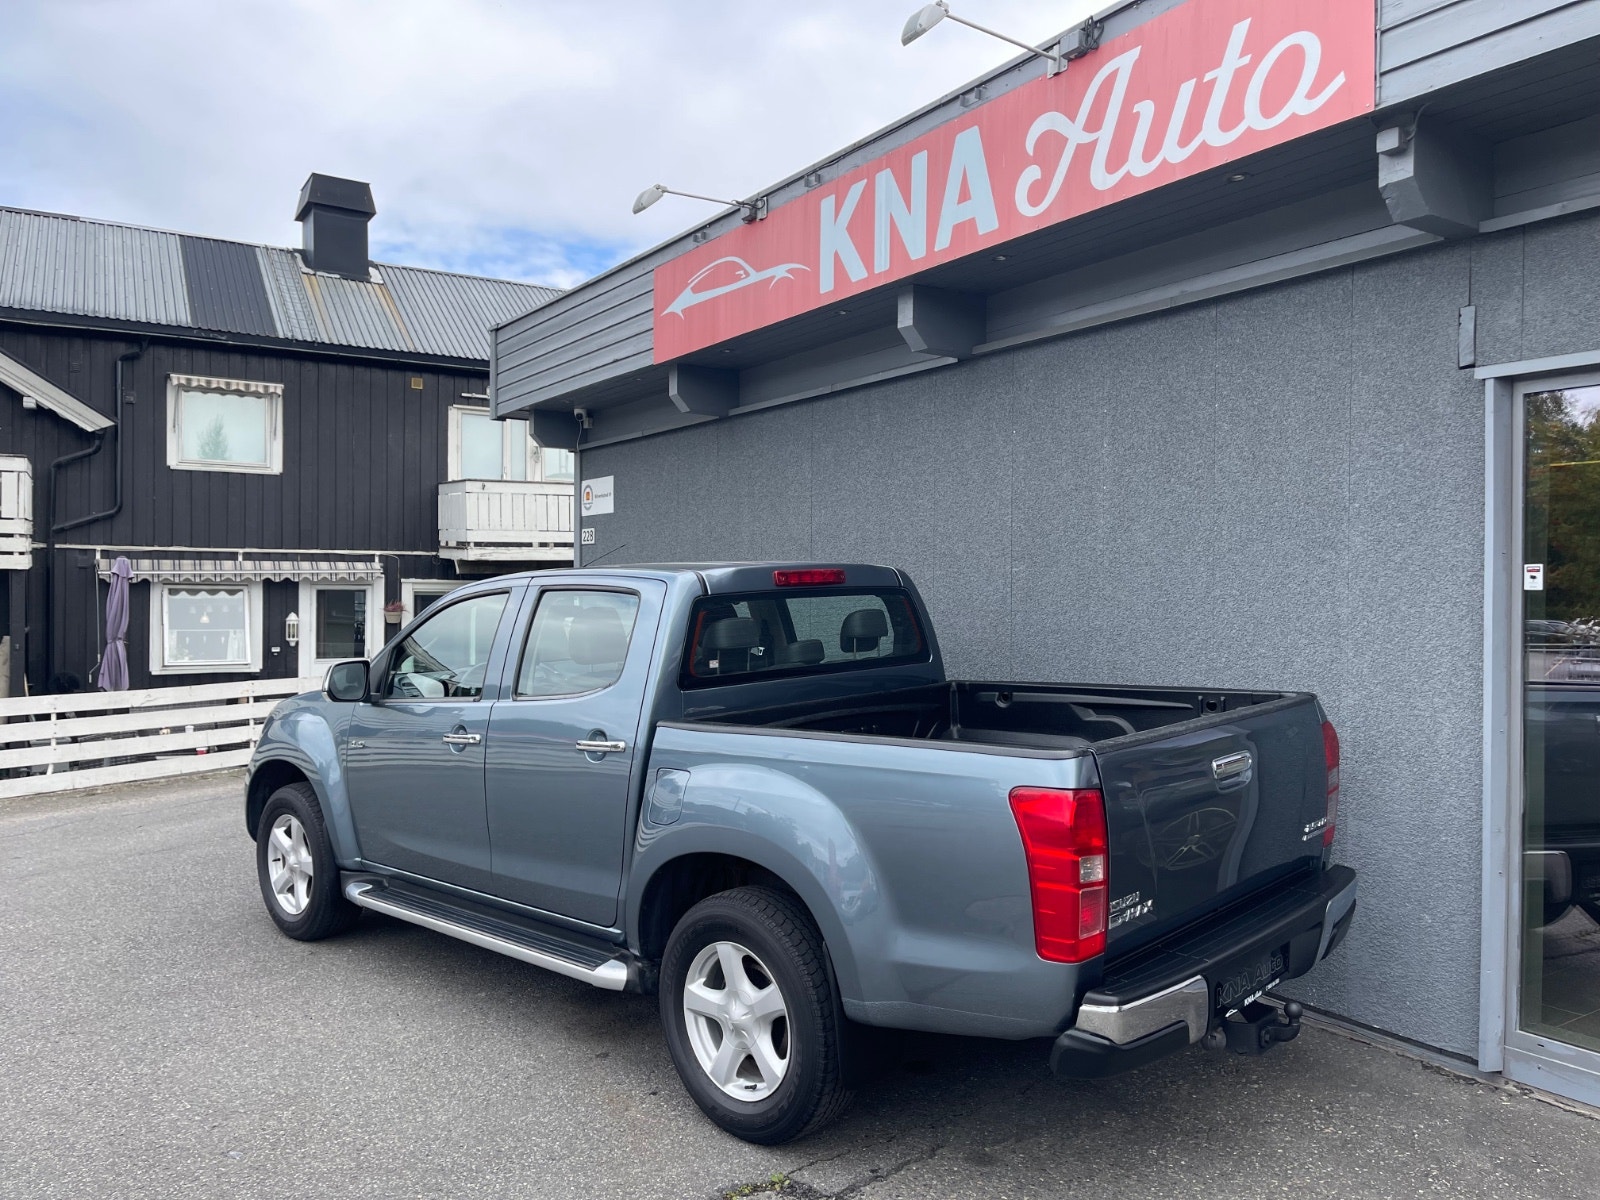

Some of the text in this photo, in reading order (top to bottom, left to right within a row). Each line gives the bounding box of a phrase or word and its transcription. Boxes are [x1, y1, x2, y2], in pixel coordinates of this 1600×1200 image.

[819, 17, 1346, 295] KNA Auto
[583, 530, 593, 542] 228
[1216, 972, 1251, 1009] KNA
